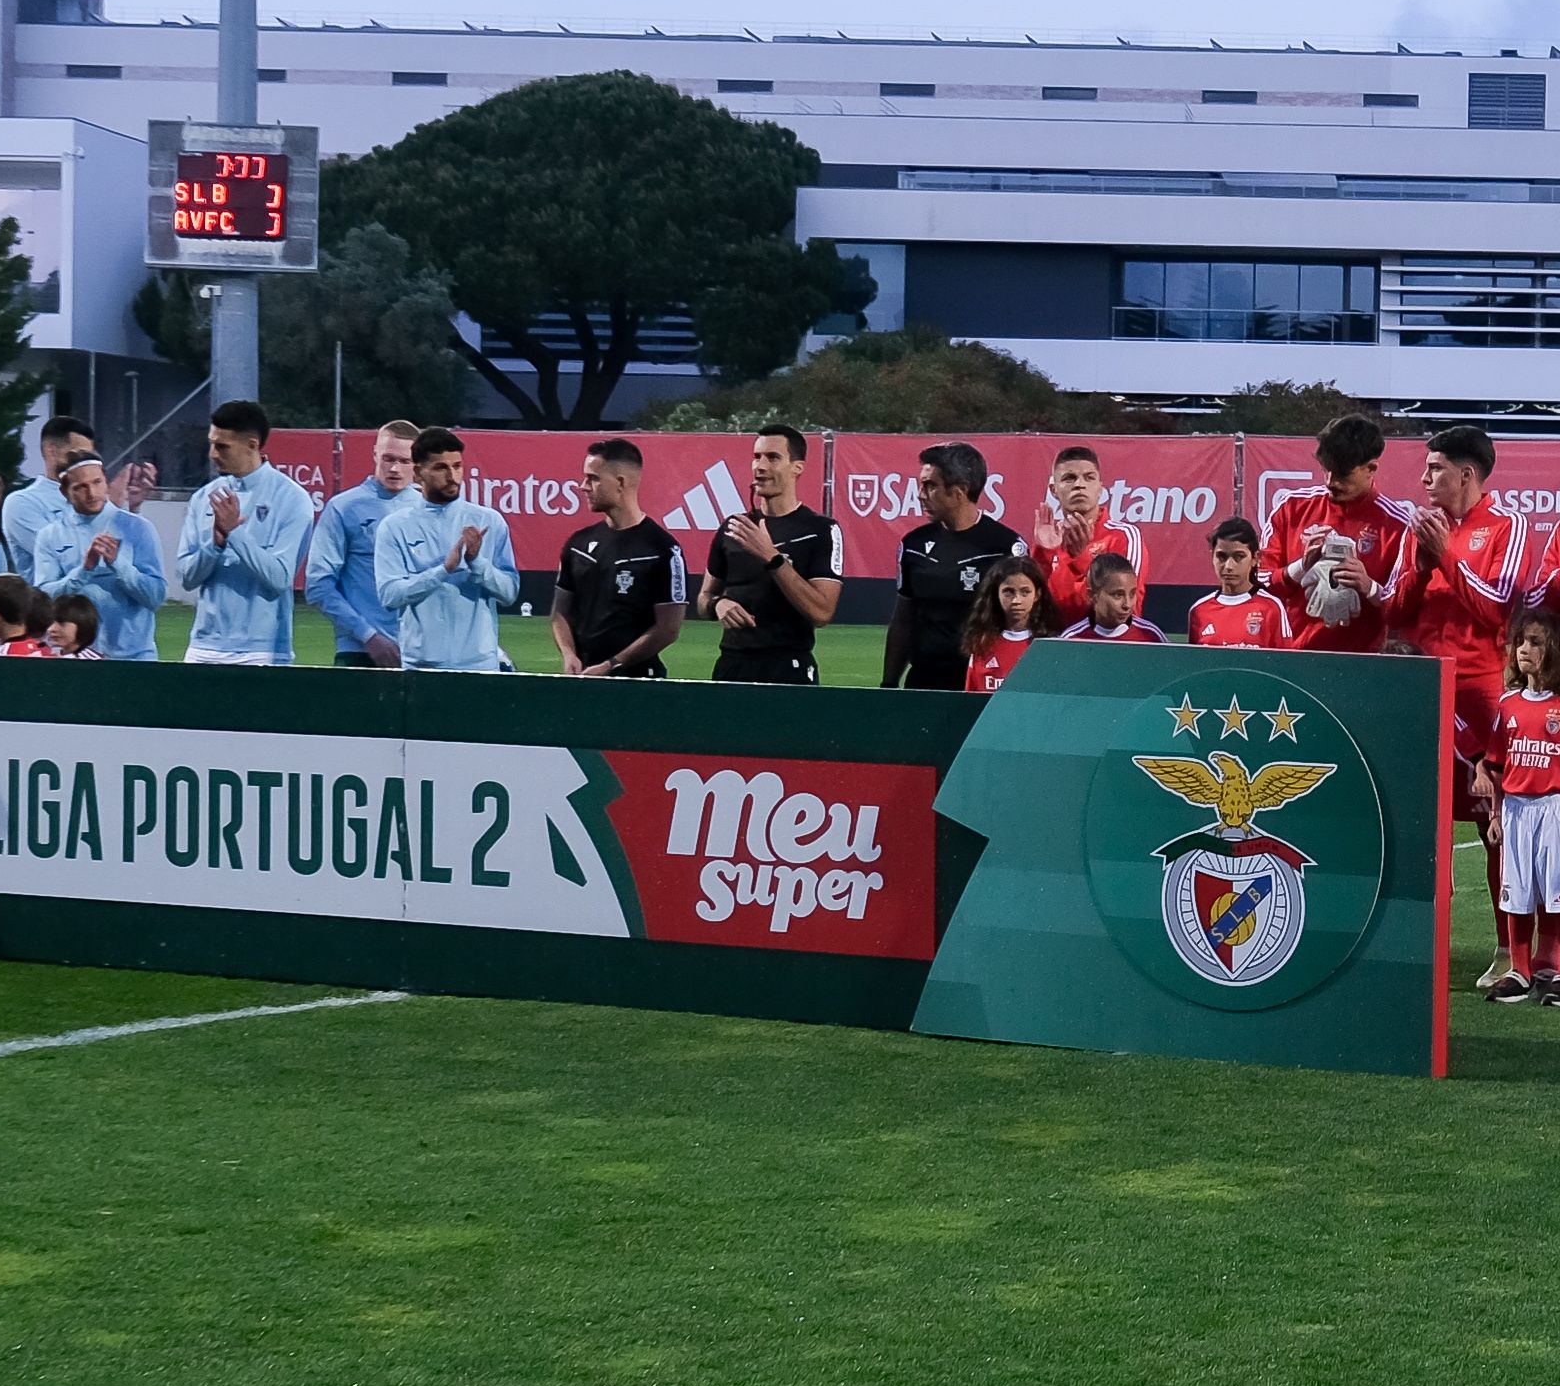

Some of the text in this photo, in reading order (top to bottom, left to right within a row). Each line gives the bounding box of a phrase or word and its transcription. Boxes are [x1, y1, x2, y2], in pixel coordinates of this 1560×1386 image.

[173, 182, 228, 205] SLB
[173, 210, 235, 232] AVFC
[460, 467, 581, 515] irates
[880, 473, 1005, 521] SAS
[122, 763, 453, 885] PORTUGAL
[470, 780, 511, 888] 2
